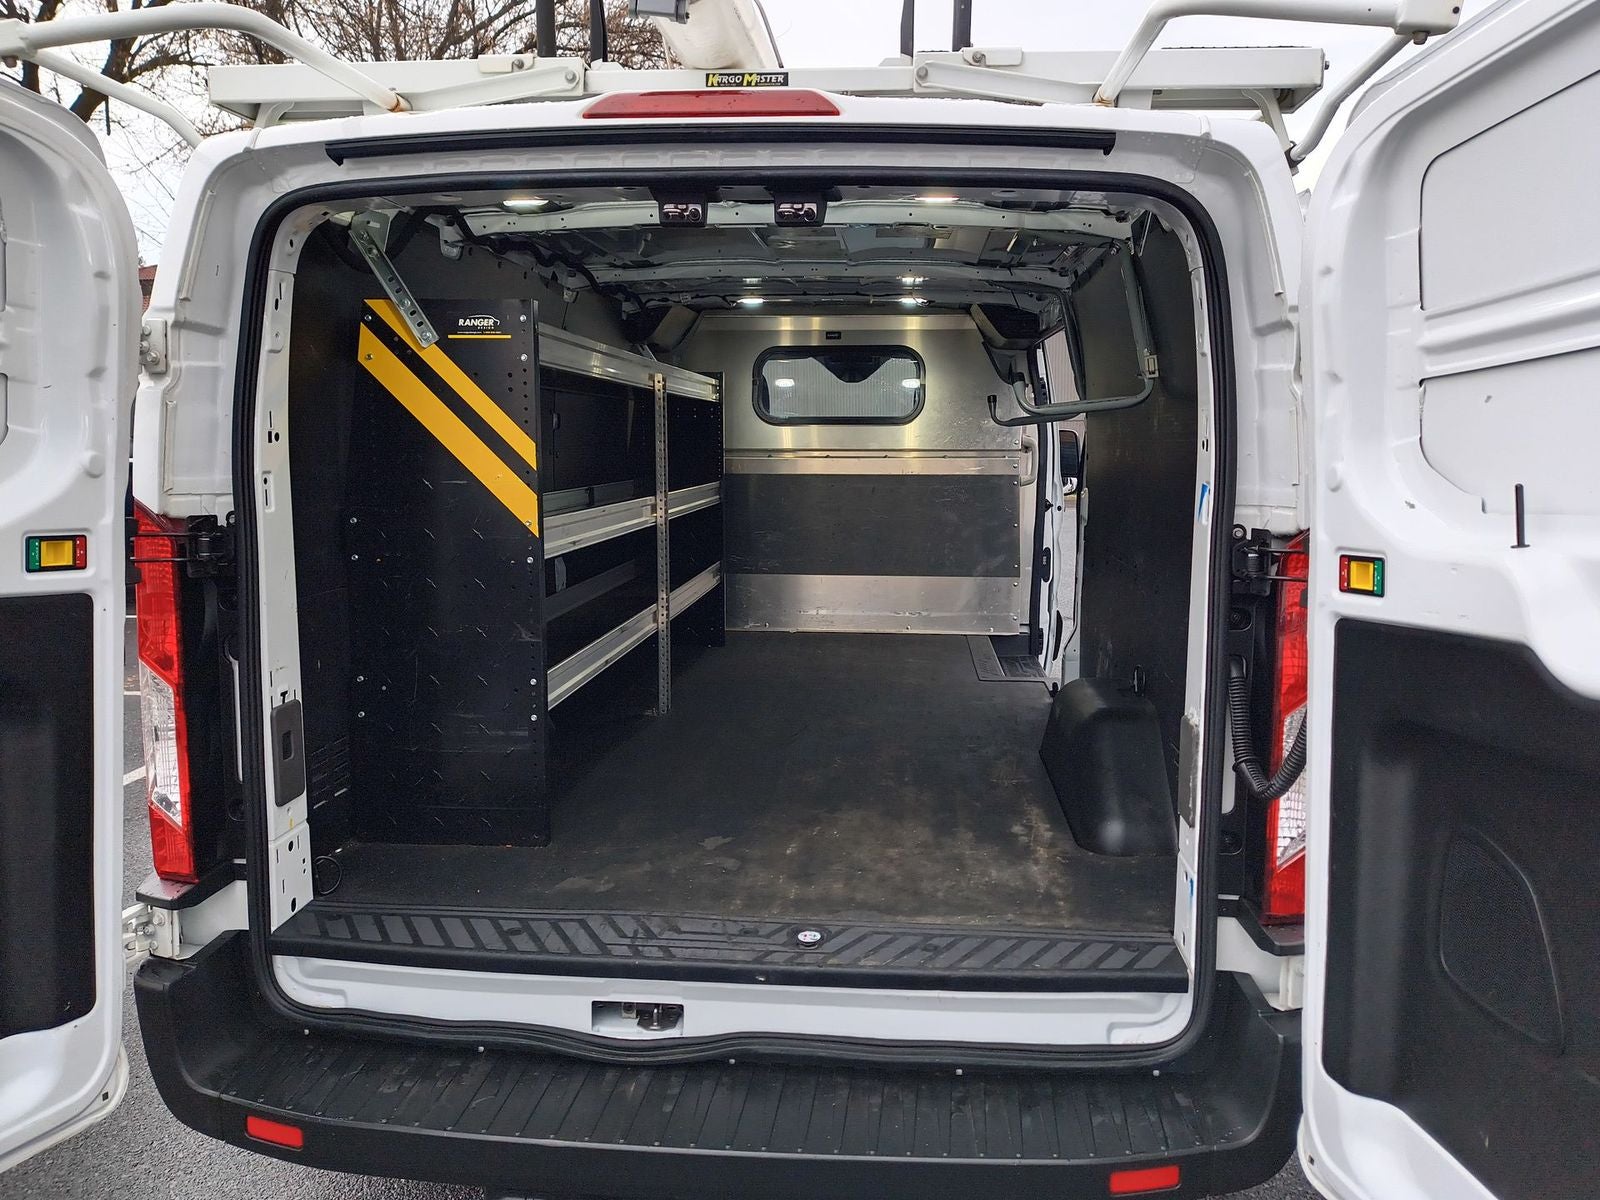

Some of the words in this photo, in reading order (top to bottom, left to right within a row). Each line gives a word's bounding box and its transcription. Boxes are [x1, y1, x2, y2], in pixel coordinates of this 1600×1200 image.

[707, 73, 743, 86] KARGO
[743, 73, 784, 86] MASTER
[458, 318, 494, 326] RANGER
